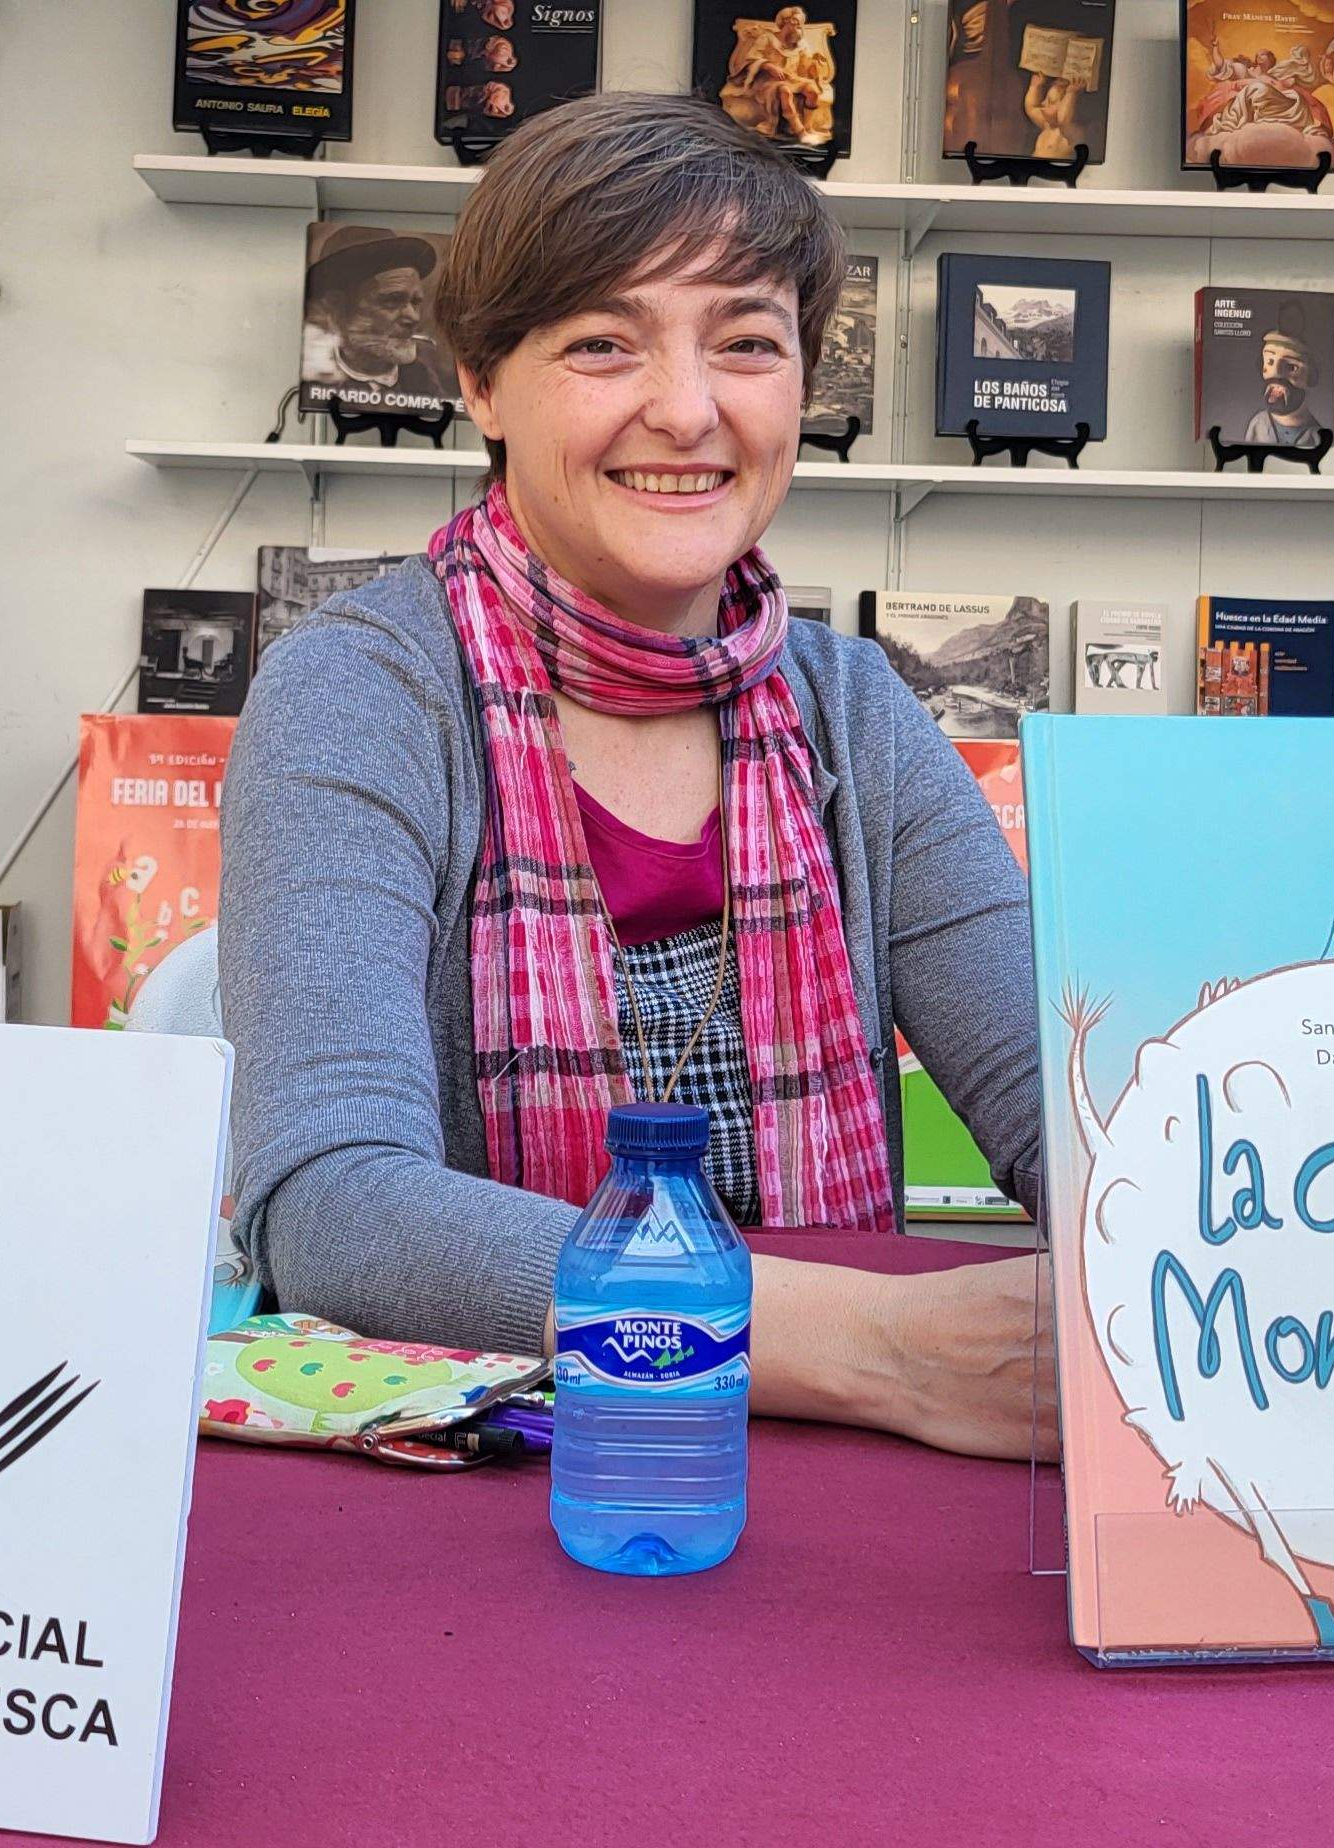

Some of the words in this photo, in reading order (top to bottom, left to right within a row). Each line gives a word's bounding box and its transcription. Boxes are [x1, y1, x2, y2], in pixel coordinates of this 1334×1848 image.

[531, 4, 595, 27] Signos
[195, 99, 244, 111] ANTONIO
[247, 101, 284, 114] SAURA
[292, 105, 330, 118] ELEGÍA
[1214, 299, 1237, 308] ARTE
[1214, 309, 1251, 319] INGENUO
[974, 380, 999, 394] LOS
[1003, 381, 1047, 397] BAÑOS
[310, 387, 381, 405] RICARDO
[384, 393, 465, 412] COMPAÉ
[974, 395, 991, 408] DE
[994, 396, 1067, 413] PANTICOSA
[885, 602, 936, 612] BERTRAND
[939, 604, 952, 612] DE
[954, 605, 990, 614] LASSUS
[1215, 611, 1248, 622] Huesca
[1249, 614, 1260, 622] en
[1262, 613, 1271, 623] la
[1273, 614, 1296, 624] Edad
[1298, 615, 1327, 625] Media
[111, 777, 168, 806] FERIA
[173, 779, 210, 808] DEL
[614, 1319, 683, 1336] MONTE
[623, 1334, 683, 1350] PINOS
[569, 1373, 581, 1385] ml
[714, 1374, 736, 1391] 330
